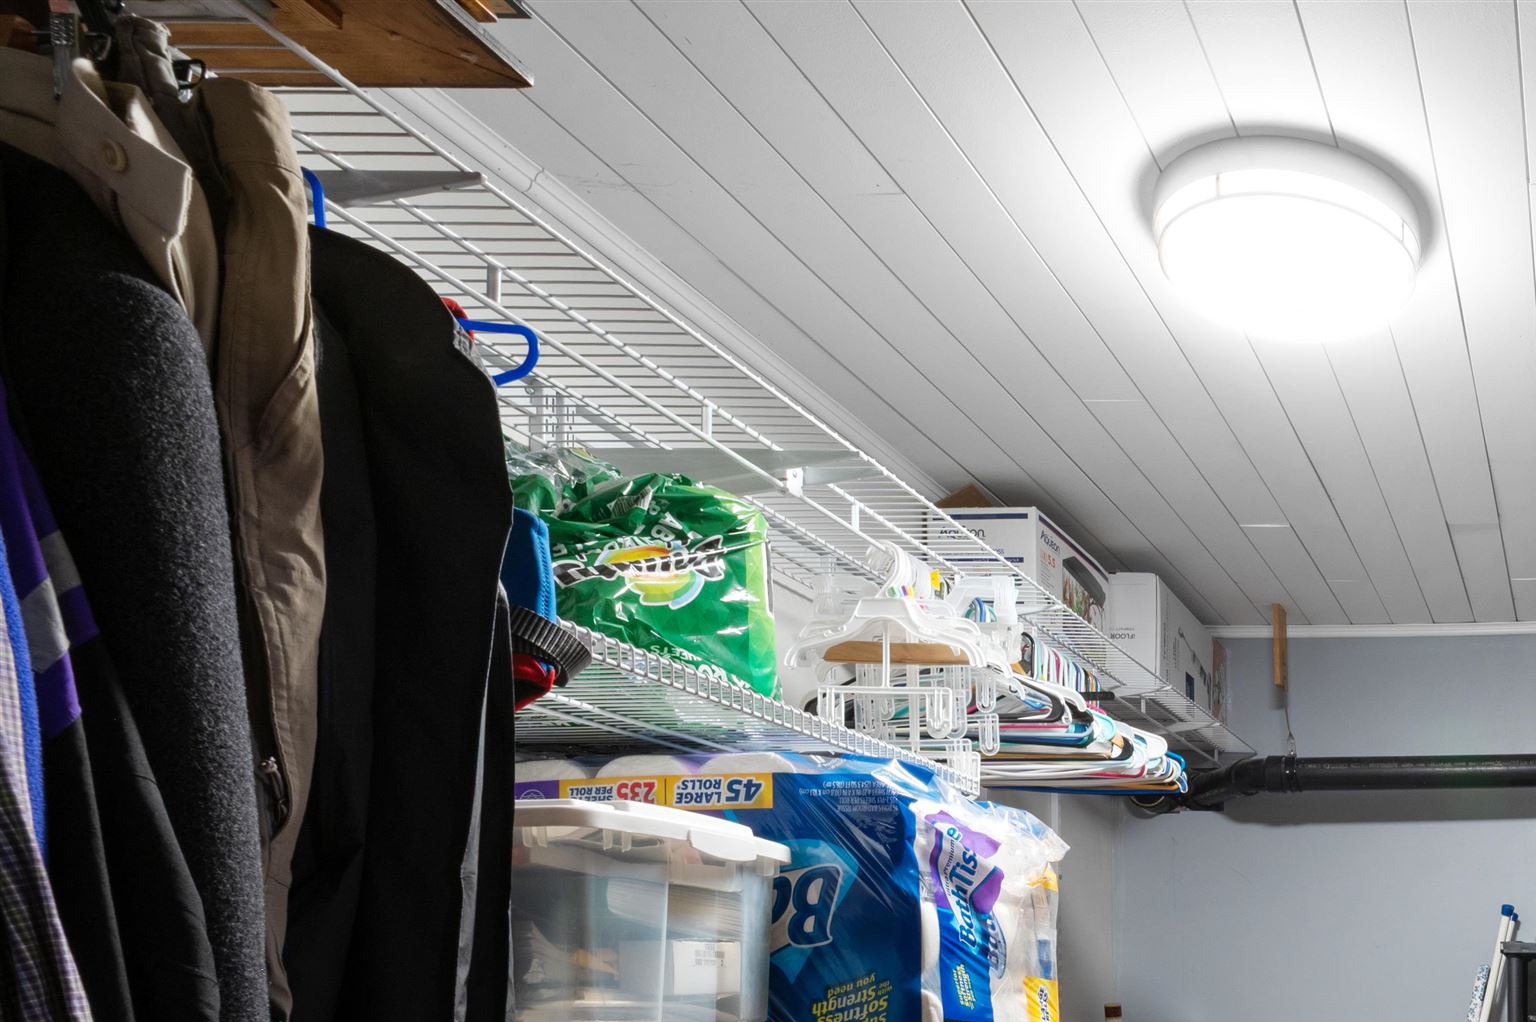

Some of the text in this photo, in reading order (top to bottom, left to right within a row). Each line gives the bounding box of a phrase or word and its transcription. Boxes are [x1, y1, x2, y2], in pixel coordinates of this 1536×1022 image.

[569, 786, 613, 796] PER ROLL
[616, 782, 656, 804] 235
[675, 778, 763, 804] 45 LARGE
[680, 778, 722, 791] ROLLS
[943, 839, 956, 876] Premium
[950, 887, 977, 948] Bath
[827, 972, 876, 999] you need
[812, 986, 876, 1017] Strength
